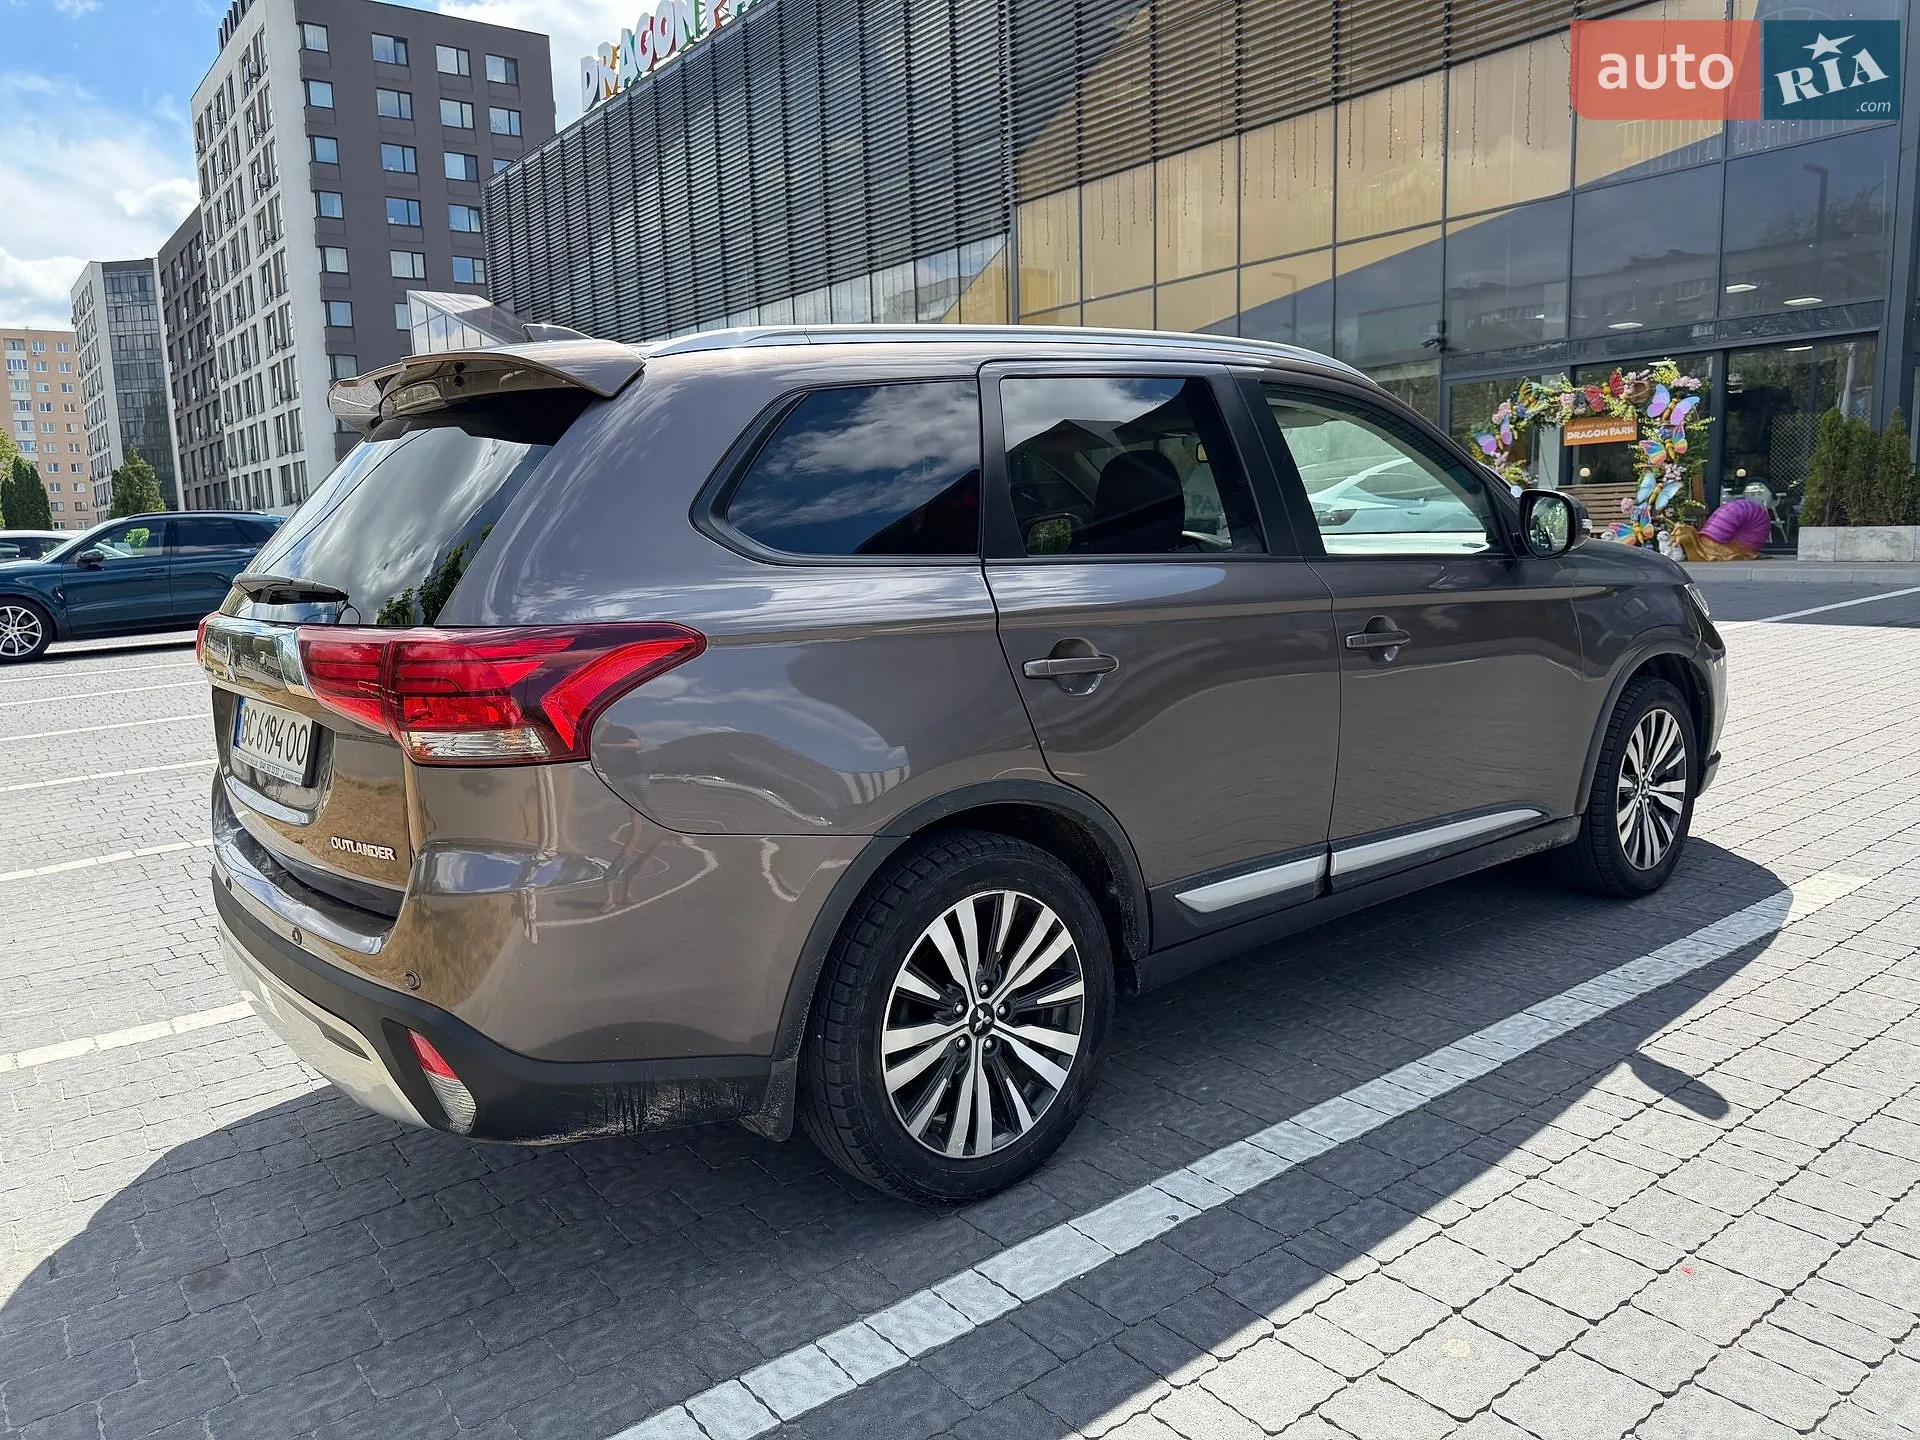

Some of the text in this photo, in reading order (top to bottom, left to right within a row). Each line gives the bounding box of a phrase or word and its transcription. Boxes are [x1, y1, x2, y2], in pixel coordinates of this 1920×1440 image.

[581, 0, 699, 112] DRAGON
[1566, 426, 1634, 440] DRAGON PARK
[257, 712, 286, 759] 6194
[330, 836, 396, 861] OUTLANDER
